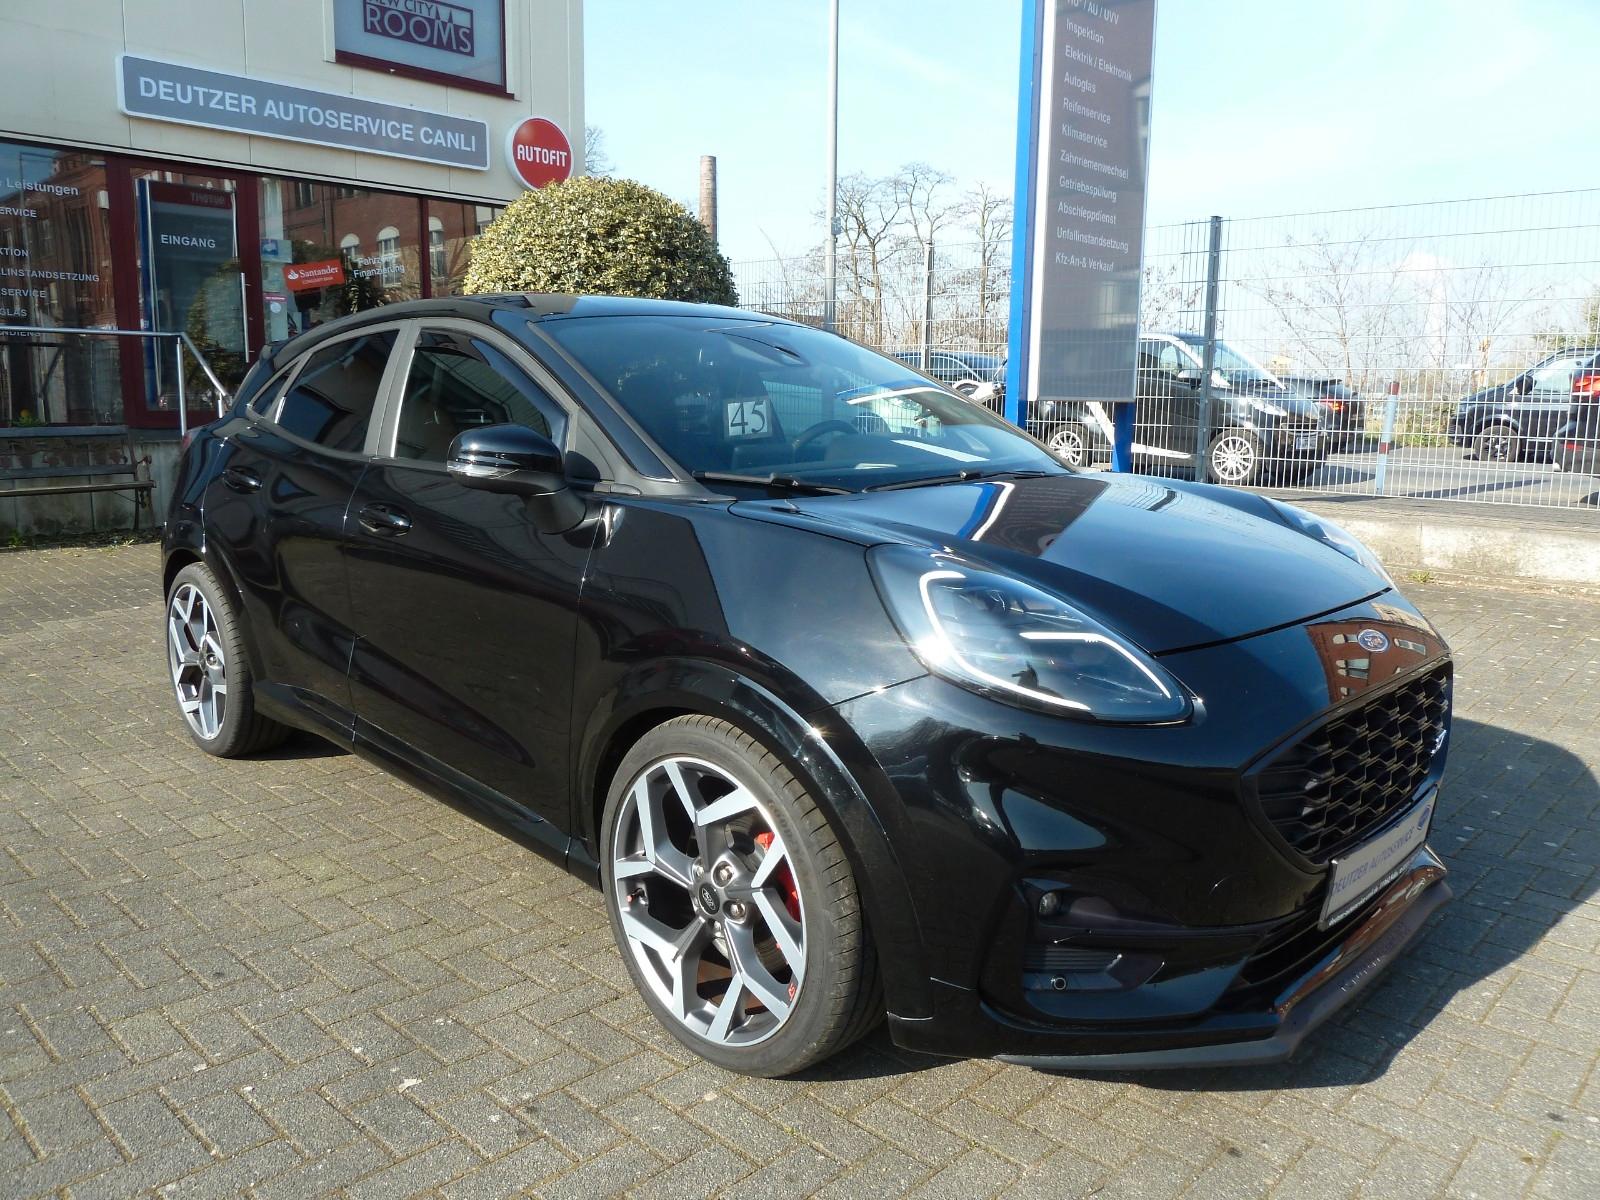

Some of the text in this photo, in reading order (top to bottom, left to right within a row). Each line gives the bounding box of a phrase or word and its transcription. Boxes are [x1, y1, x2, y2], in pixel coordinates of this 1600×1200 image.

[1087, 1, 1098, 16] AU
[1103, 8, 1119, 25] UVV
[366, 4, 472, 53] ROOMS
[1066, 18, 1104, 44] Inspektion
[1065, 45, 1093, 67] Elektrik
[1098, 58, 1133, 82] Elektronik
[1064, 71, 1096, 94] Autoglas
[139, 76, 475, 152] DEUTZER AUTOSERVICE CANLI
[1063, 98, 1111, 125] Reifenservice
[1061, 124, 1108, 148] Klimaservice
[517, 144, 567, 167] AUTOFIT
[1060, 150, 1129, 179] Zahnriemenwechsel
[7, 178, 79, 196] Leistungen
[1057, 202, 1117, 225] Abschleppdienst
[161, 234, 216, 248] EINGANG
[1056, 226, 1129, 254] Unfallinstandsetzung
[299, 265, 338, 278] Santander
[353, 263, 405, 279] Finanzierung
[730, 400, 766, 434] 45
